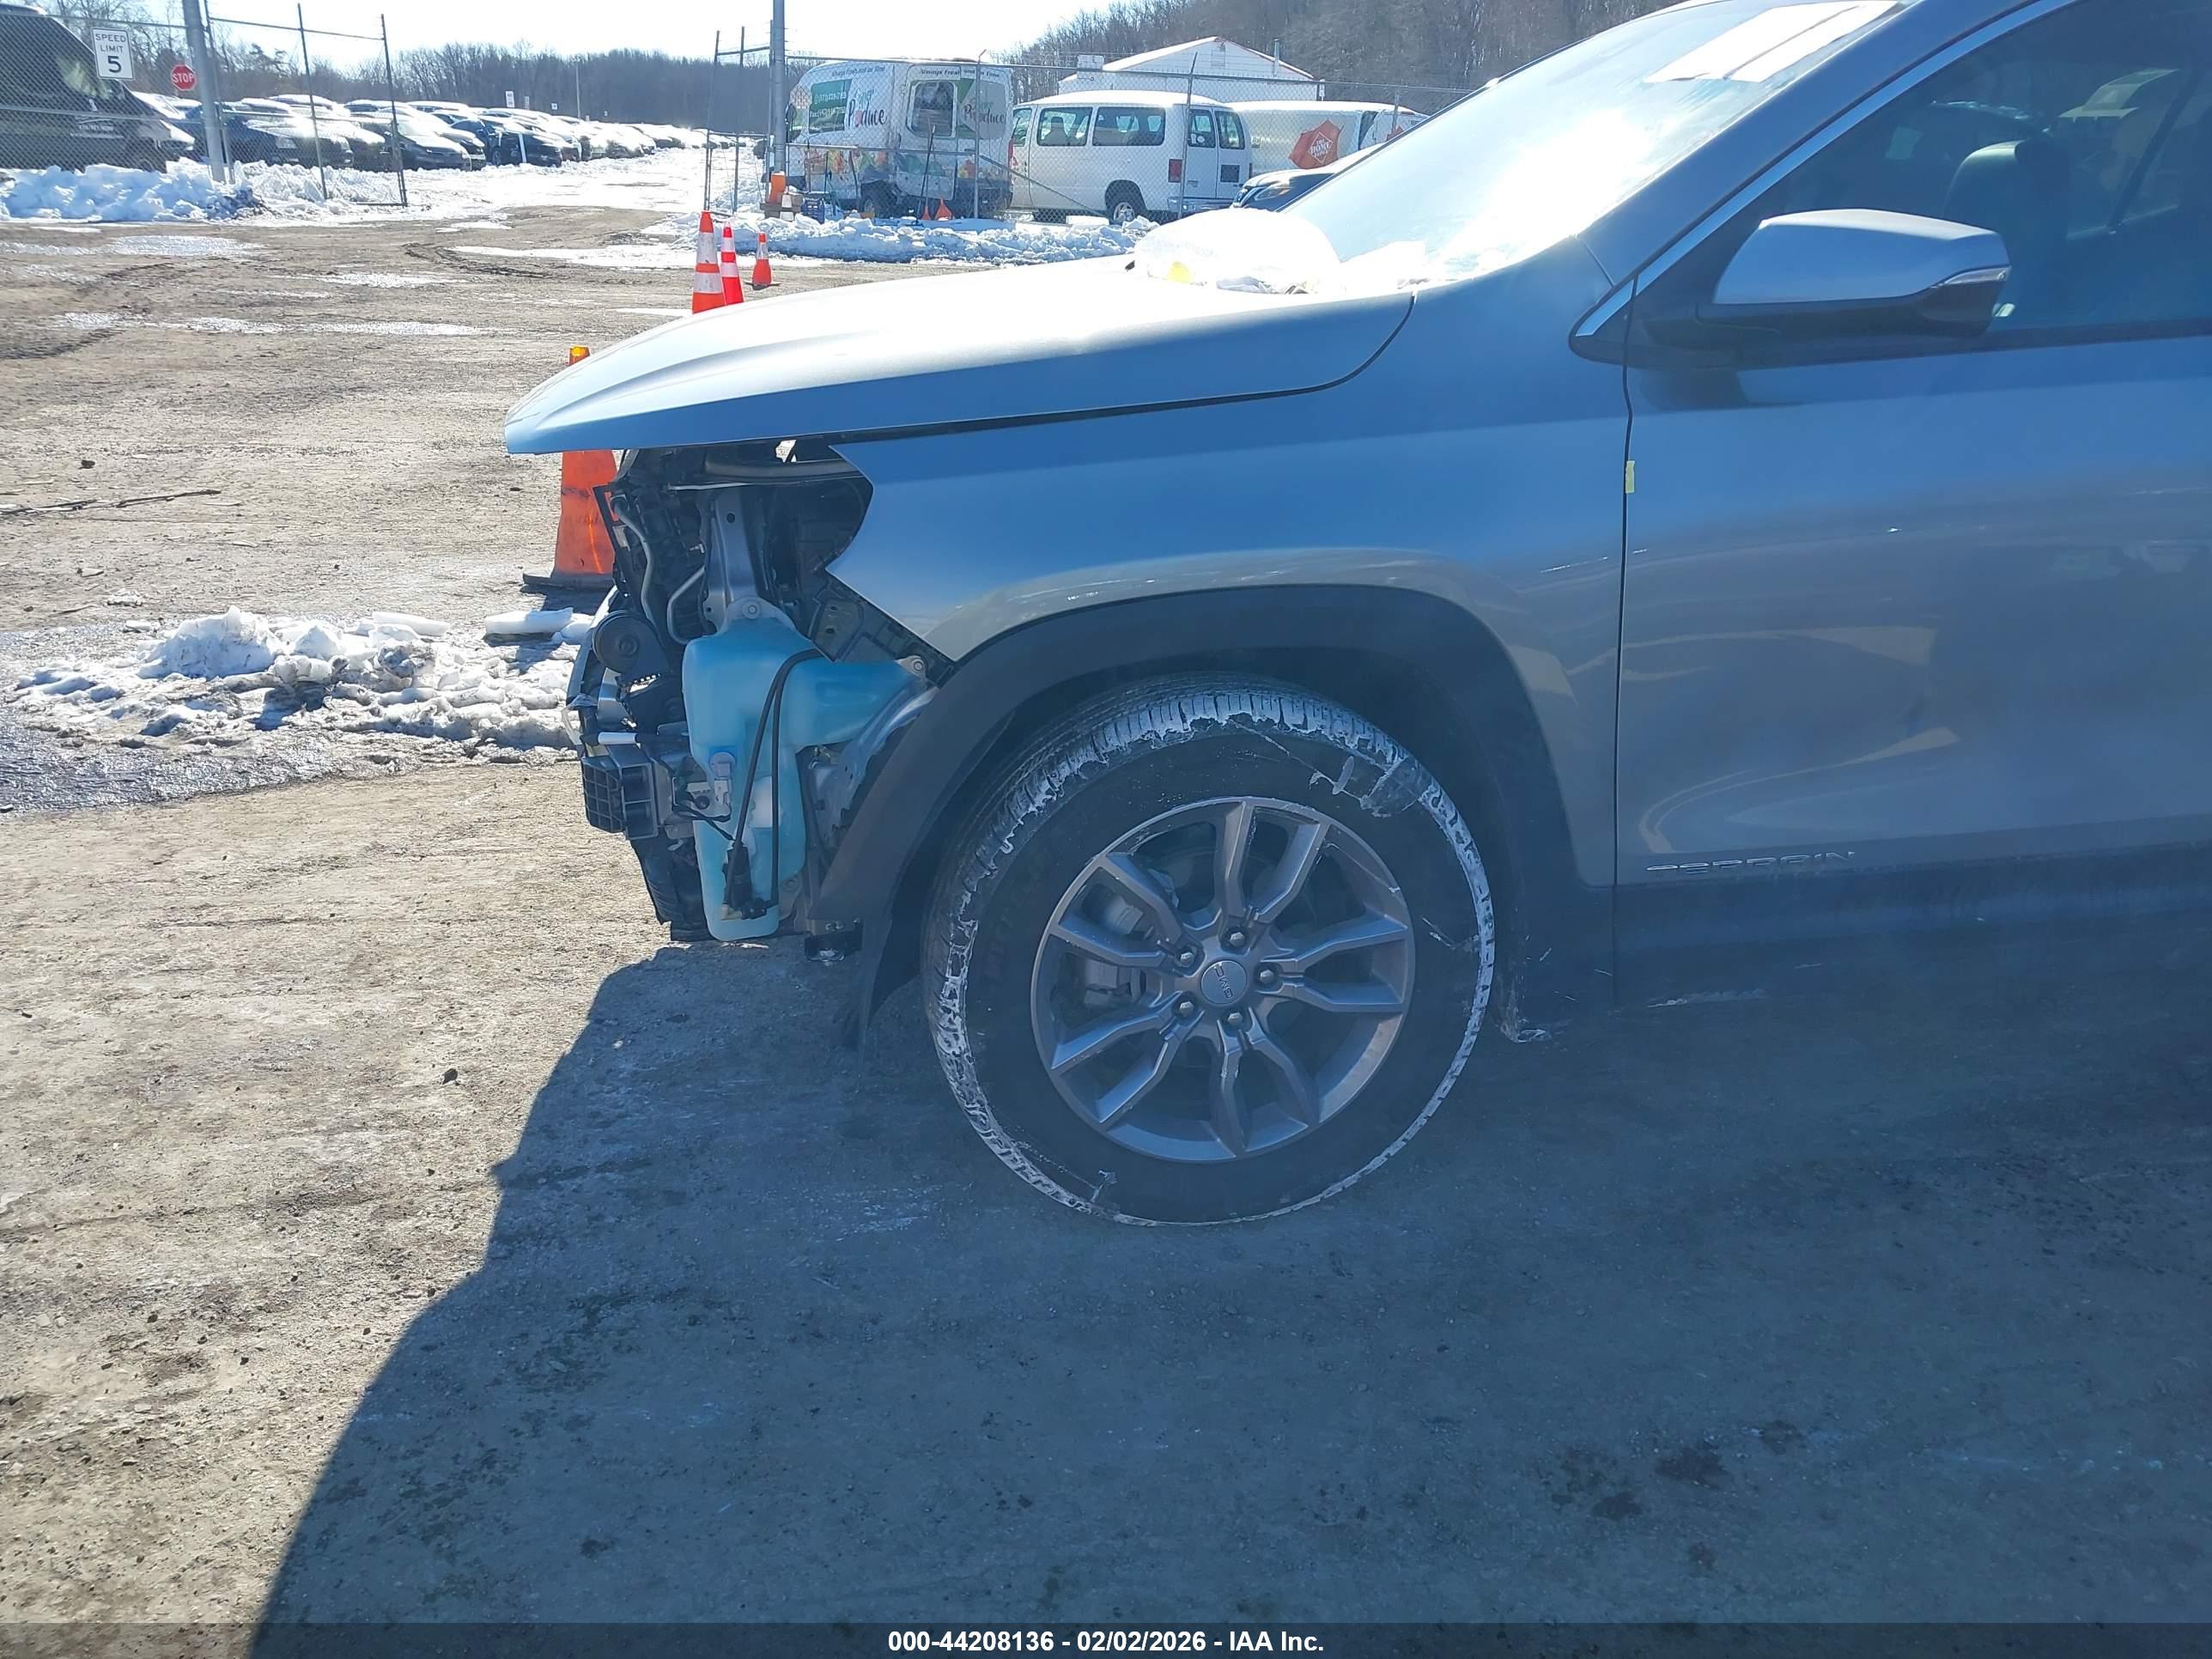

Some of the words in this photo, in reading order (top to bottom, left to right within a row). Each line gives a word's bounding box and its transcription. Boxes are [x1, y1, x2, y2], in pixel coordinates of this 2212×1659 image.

[95, 33, 126, 42] SPEED
[107, 56, 122, 73] 5
[173, 72, 195, 83] STOP
[1213, 963, 1233, 999] GMC
